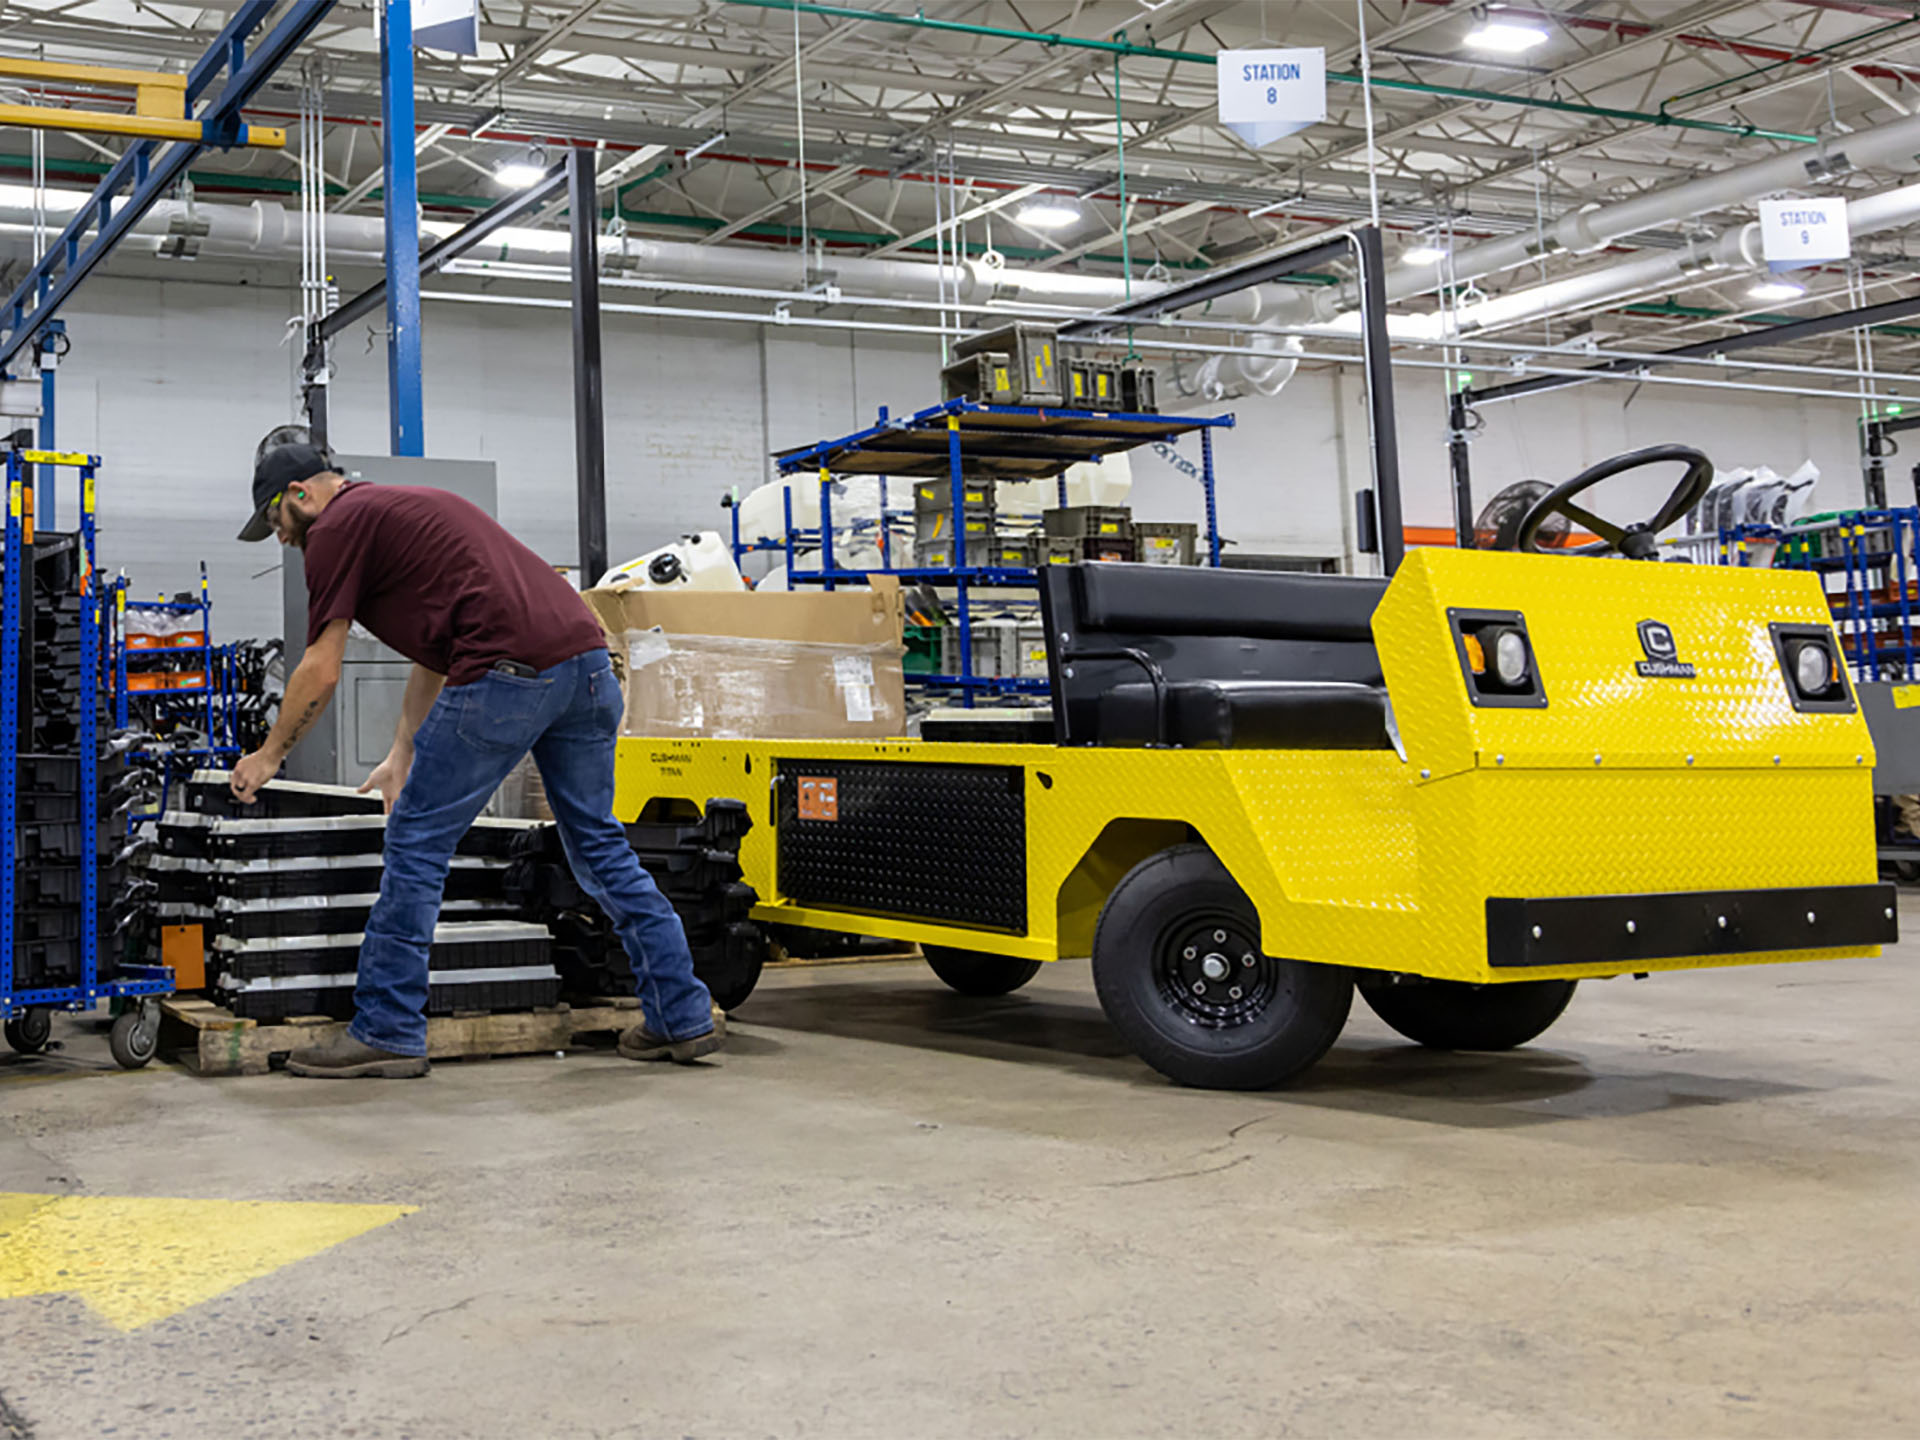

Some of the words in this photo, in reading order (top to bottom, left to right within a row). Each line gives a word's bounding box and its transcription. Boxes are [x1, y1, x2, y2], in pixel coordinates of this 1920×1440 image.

[1243, 63, 1300, 81] STATION
[1266, 86, 1277, 105] 8
[1780, 210, 1827, 226] STATION
[1801, 230, 1810, 245] 9
